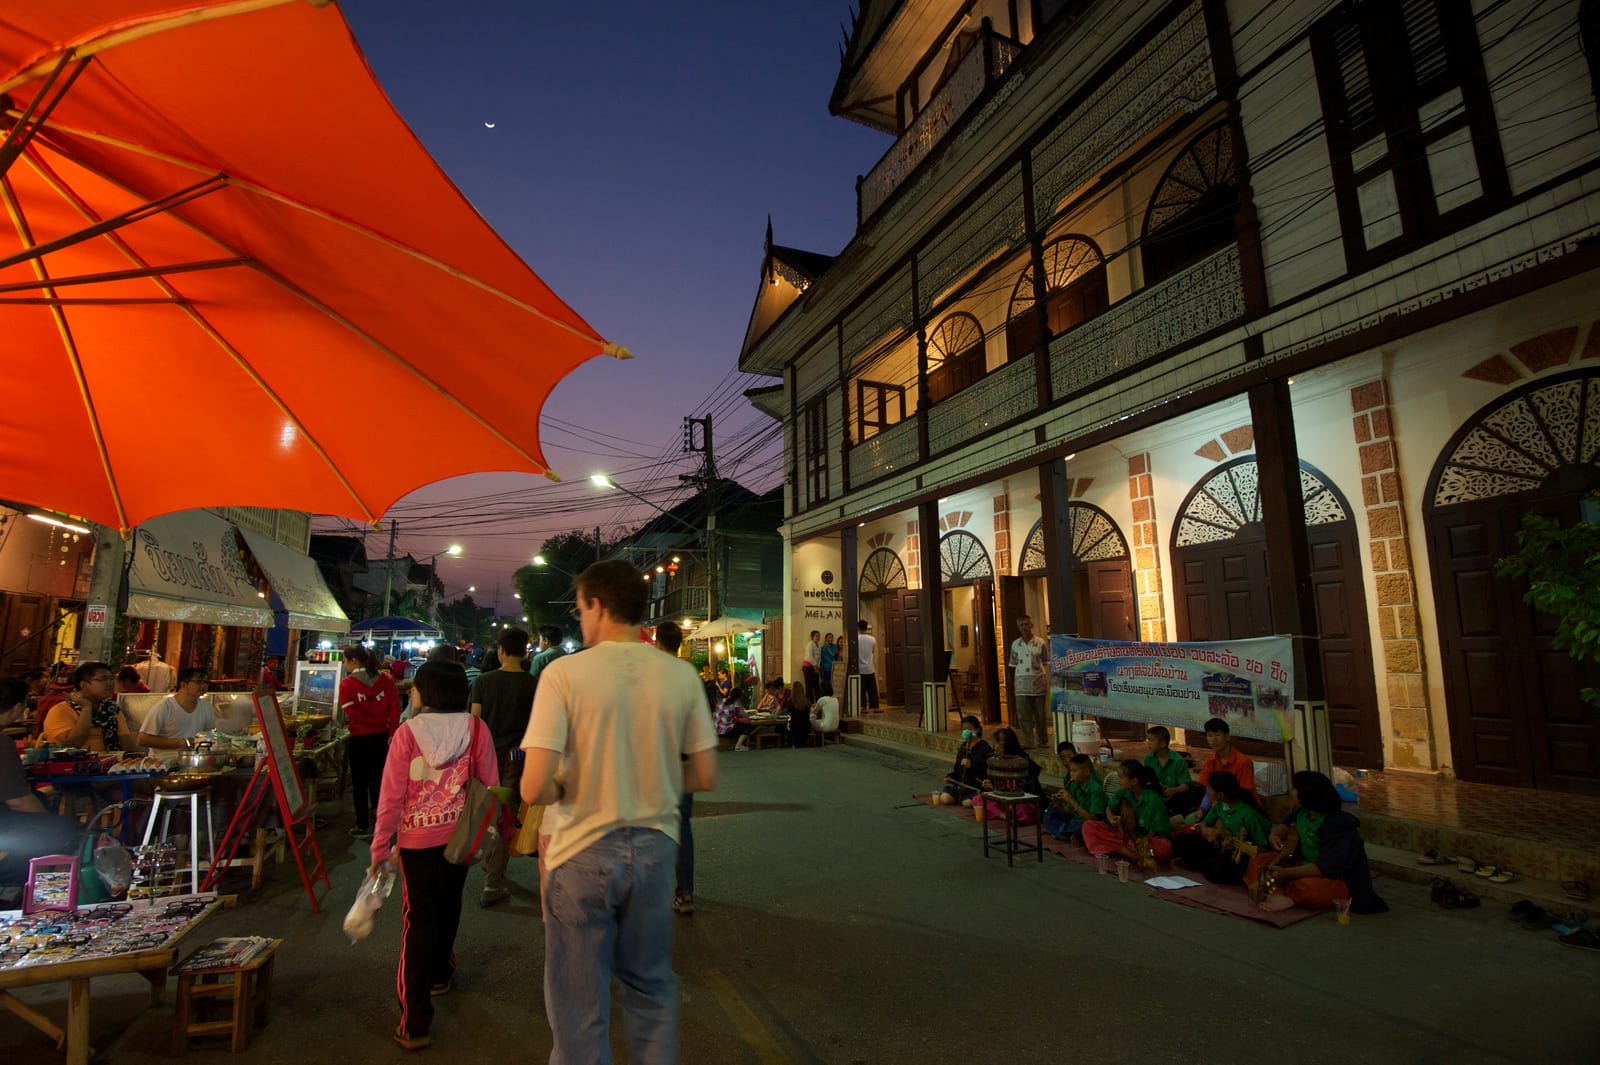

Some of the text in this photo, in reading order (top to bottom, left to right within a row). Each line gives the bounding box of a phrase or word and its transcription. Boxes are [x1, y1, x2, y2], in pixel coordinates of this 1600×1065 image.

[1116, 658, 1188, 681] นาฏศิลป์พื้นบ้าน
[1190, 649, 1240, 668] วงสะล้อ
[1108, 678, 1201, 700] โรงเรียนอนุบาลเมืองปาน
